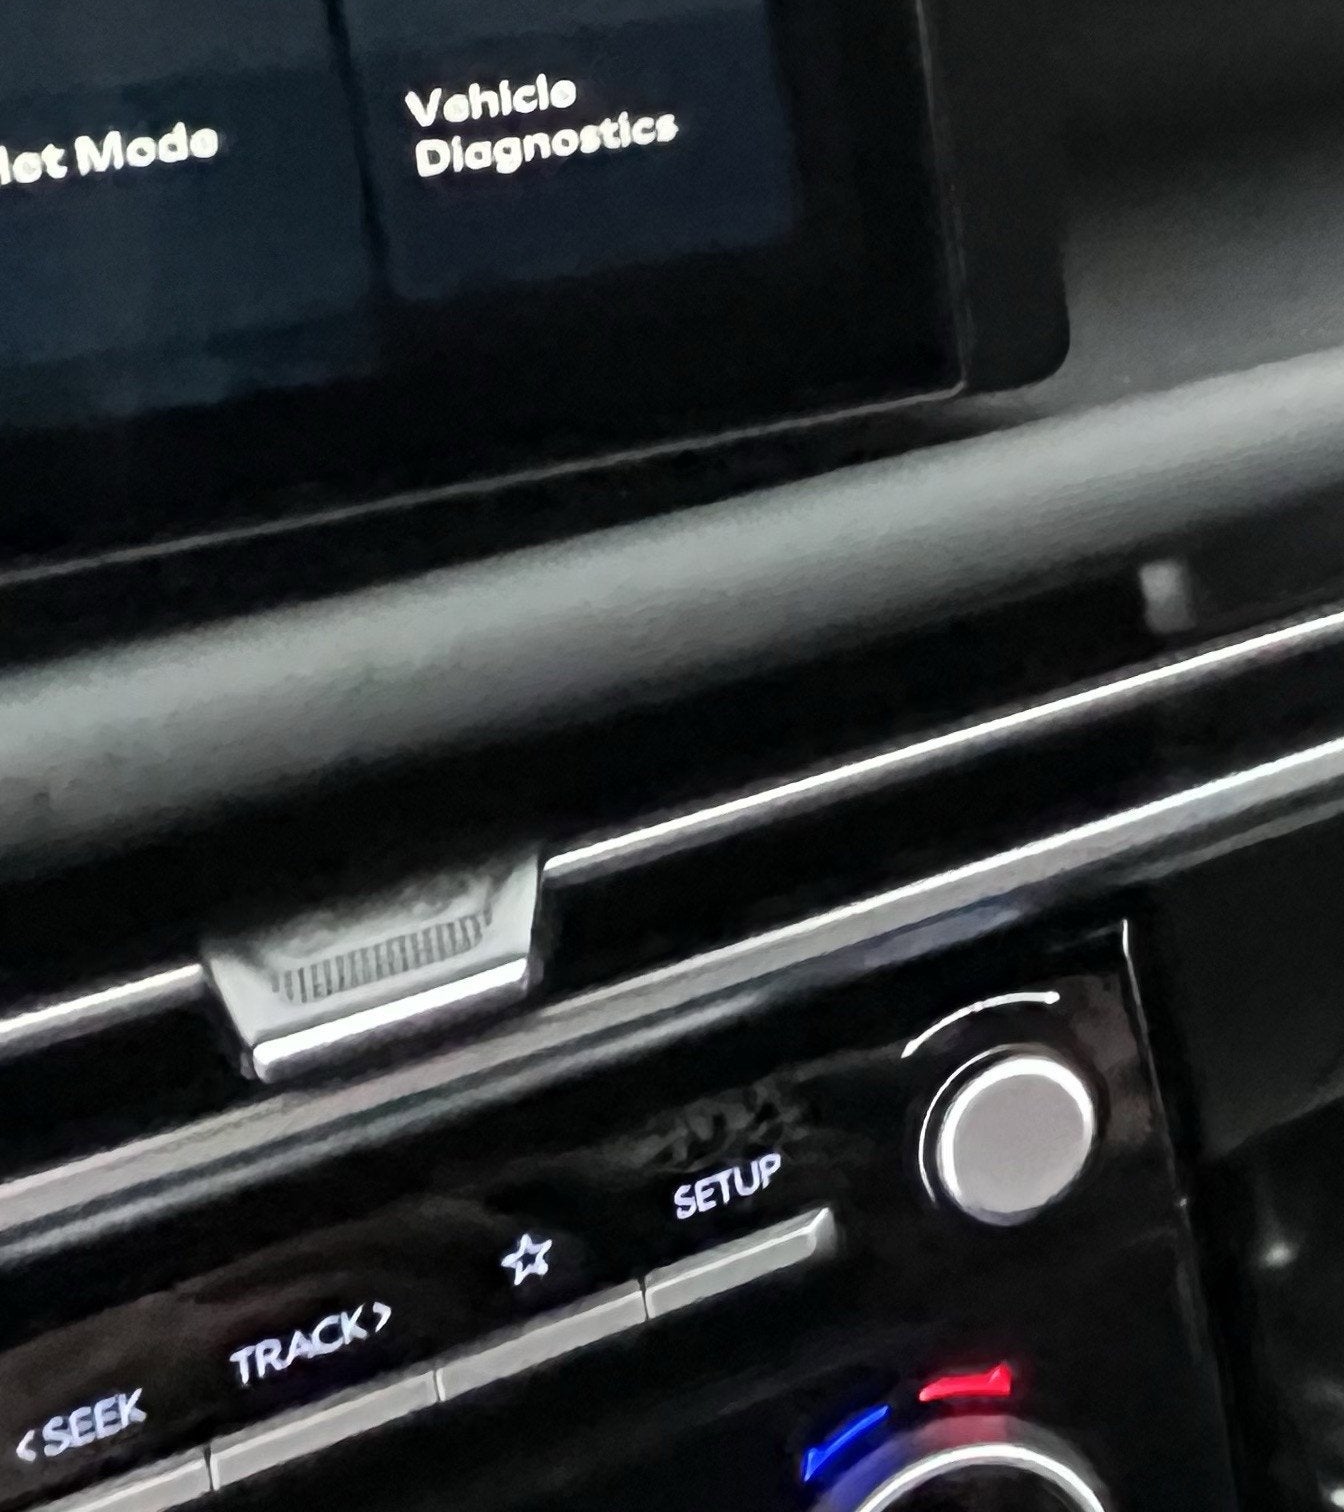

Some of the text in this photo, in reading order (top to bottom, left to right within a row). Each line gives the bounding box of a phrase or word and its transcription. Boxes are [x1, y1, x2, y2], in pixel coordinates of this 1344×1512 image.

[405, 73, 577, 127] Vehicle
[75, 122, 219, 177] Mode
[415, 111, 679, 177] Diagnostics
[674, 1153, 782, 1220] SETUP
